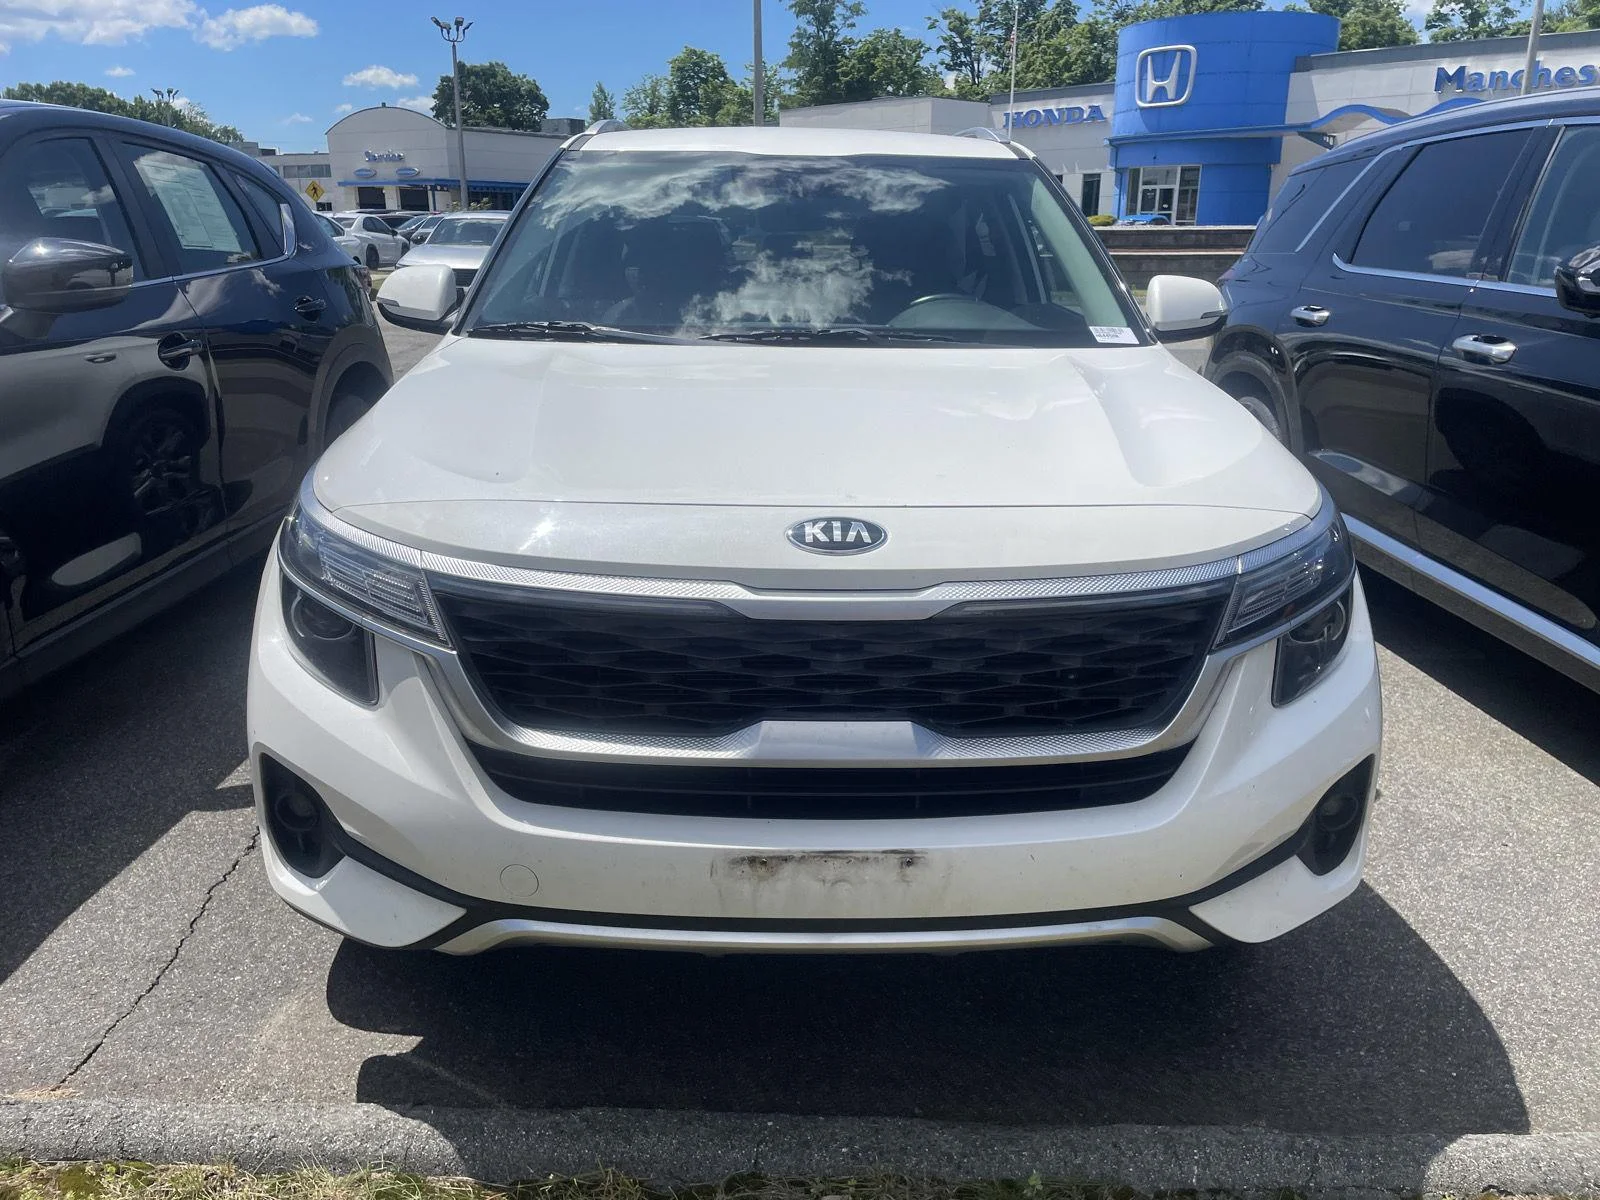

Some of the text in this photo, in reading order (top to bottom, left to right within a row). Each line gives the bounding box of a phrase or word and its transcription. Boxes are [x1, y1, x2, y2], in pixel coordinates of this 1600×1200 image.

[1434, 60, 1600, 92] Manches
[1003, 105, 1107, 129] HONDA
[803, 520, 872, 544] KIA
